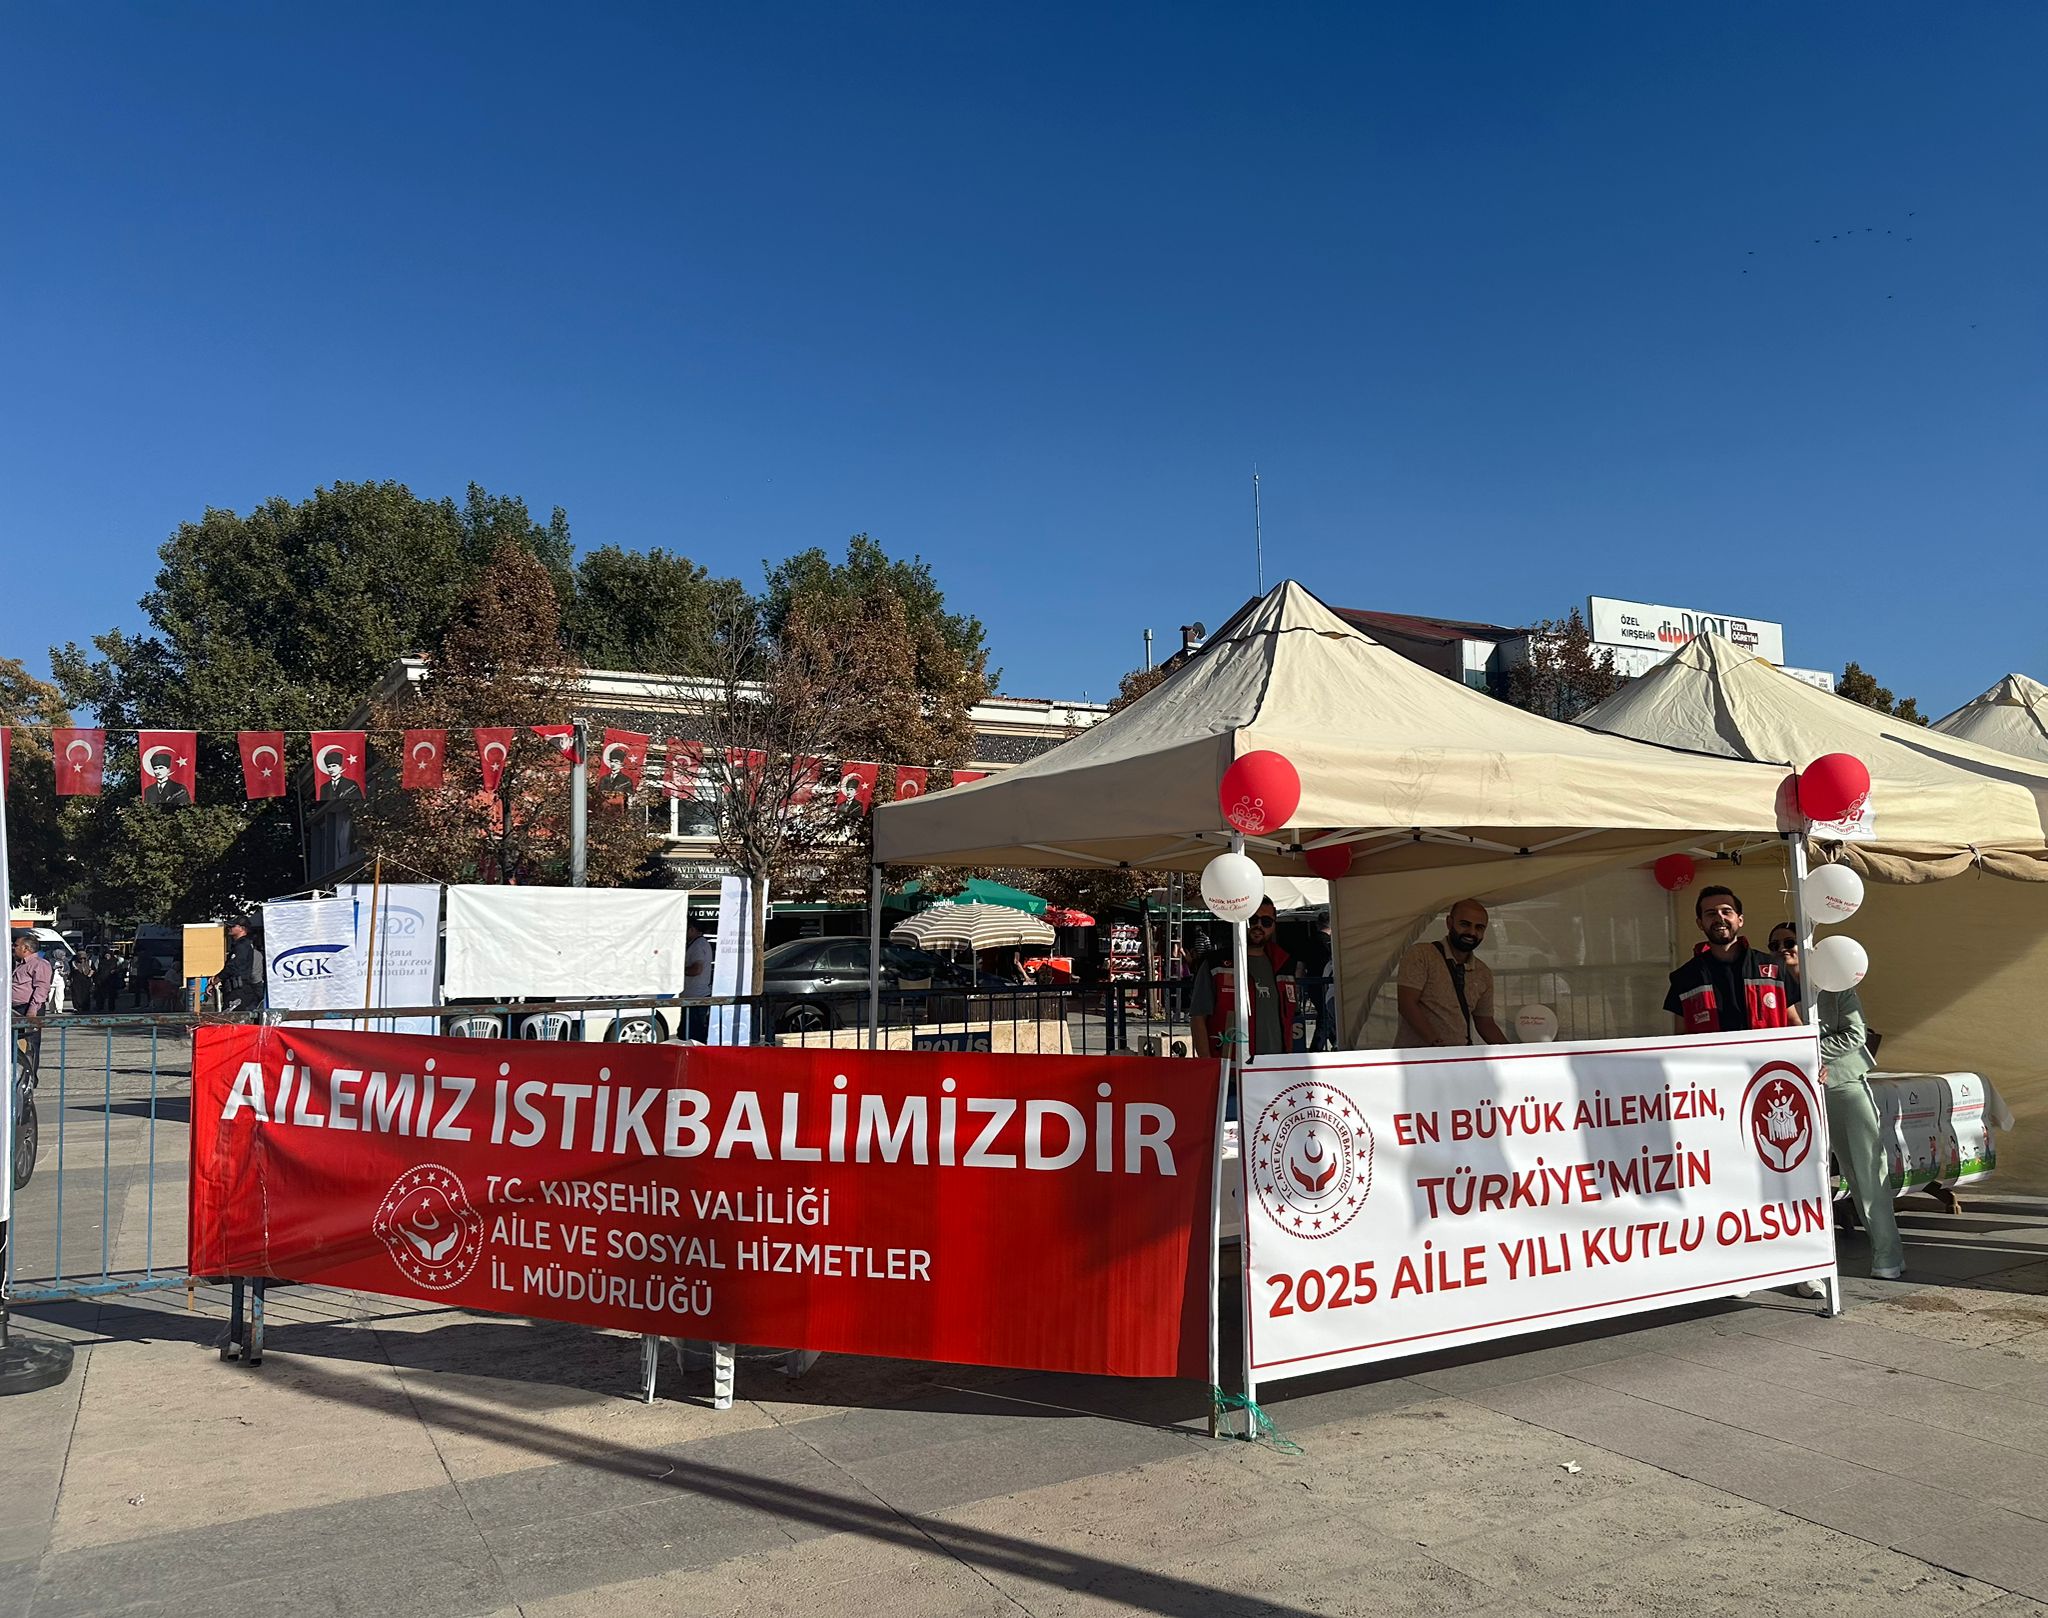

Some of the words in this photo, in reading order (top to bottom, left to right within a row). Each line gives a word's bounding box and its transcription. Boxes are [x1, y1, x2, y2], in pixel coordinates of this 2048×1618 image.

[1620, 613, 1640, 627] ÖZEL
[1621, 627, 1656, 642] KIRŞEHİR
[1731, 621, 1746, 632] ÖZEL
[282, 957, 333, 979] SGK
[220, 1048, 477, 1142] AİLEMİZ
[490, 1062, 1178, 1176] İSTİKBALİMİZDİR
[1393, 1111, 1440, 1146] EN
[1451, 1095, 1565, 1142] BÜYÜK
[1572, 1081, 1725, 1131] AİLEMİZİN,
[1273, 1141, 1283, 1156] VE
[1279, 1111, 1306, 1141] SOSYAL
[1306, 1108, 1350, 1139] HİZMETLER
[1338, 1139, 1352, 1194] BAKANLIĞI
[1416, 1141, 1711, 1219] TÜRKİYE'MİZİN
[486, 1175, 535, 1204] T.C.
[540, 1179, 681, 1218] KIRŞEHİR
[689, 1184, 830, 1226] VALİLİĞİ
[490, 1216, 553, 1251] AİLE
[559, 1224, 599, 1257] VE
[607, 1229, 726, 1271] SOSYAL
[736, 1235, 931, 1282] HİZMETLER
[1265, 1260, 1378, 1319] 2025
[1390, 1239, 1487, 1300] AİLE
[1498, 1232, 1572, 1281] YILI
[1582, 1215, 1705, 1267] KUTLU
[1716, 1196, 1825, 1247] OLSUN
[491, 1254, 515, 1292] İL
[522, 1263, 713, 1317] MÜDÜRLÜĞÜ
